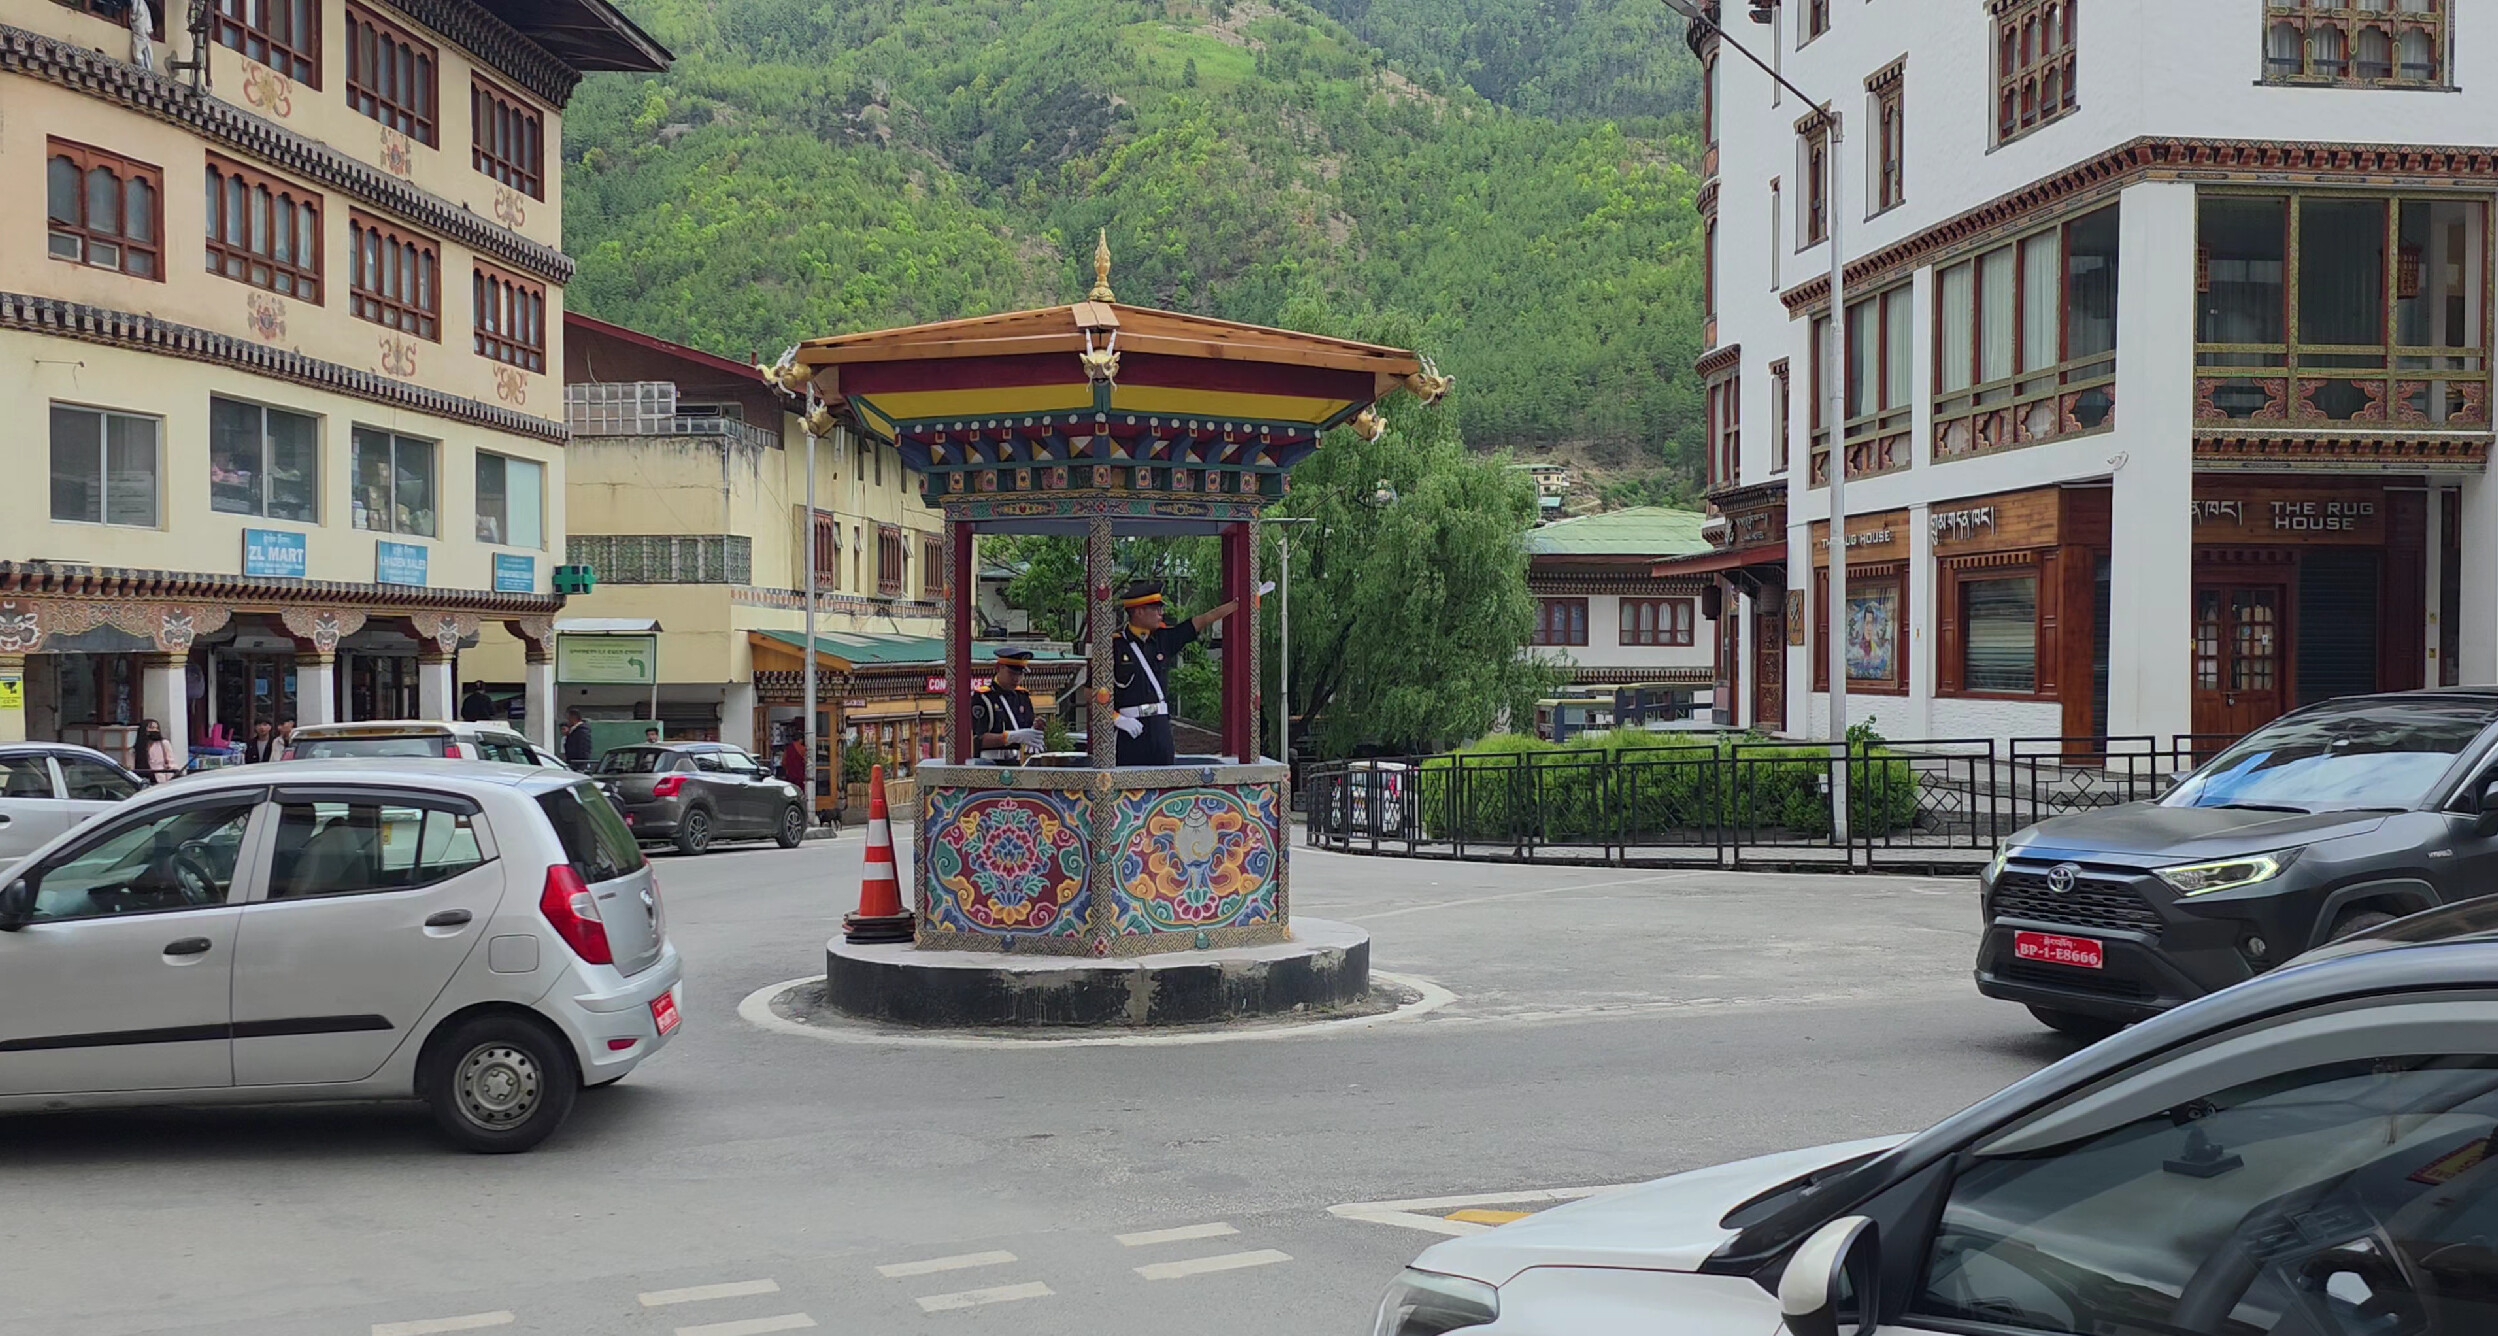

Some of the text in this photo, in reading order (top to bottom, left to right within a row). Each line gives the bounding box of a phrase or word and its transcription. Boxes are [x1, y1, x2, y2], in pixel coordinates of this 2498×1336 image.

[2270, 501, 2375, 515] THE RUG
[2275, 516, 2355, 531] HOUSE
[1845, 534, 1857, 546] UG
[1859, 529, 1891, 547] HOUSE
[248, 545, 304, 563] ZL MART
[2020, 943, 2099, 965] BP-1-E8666
